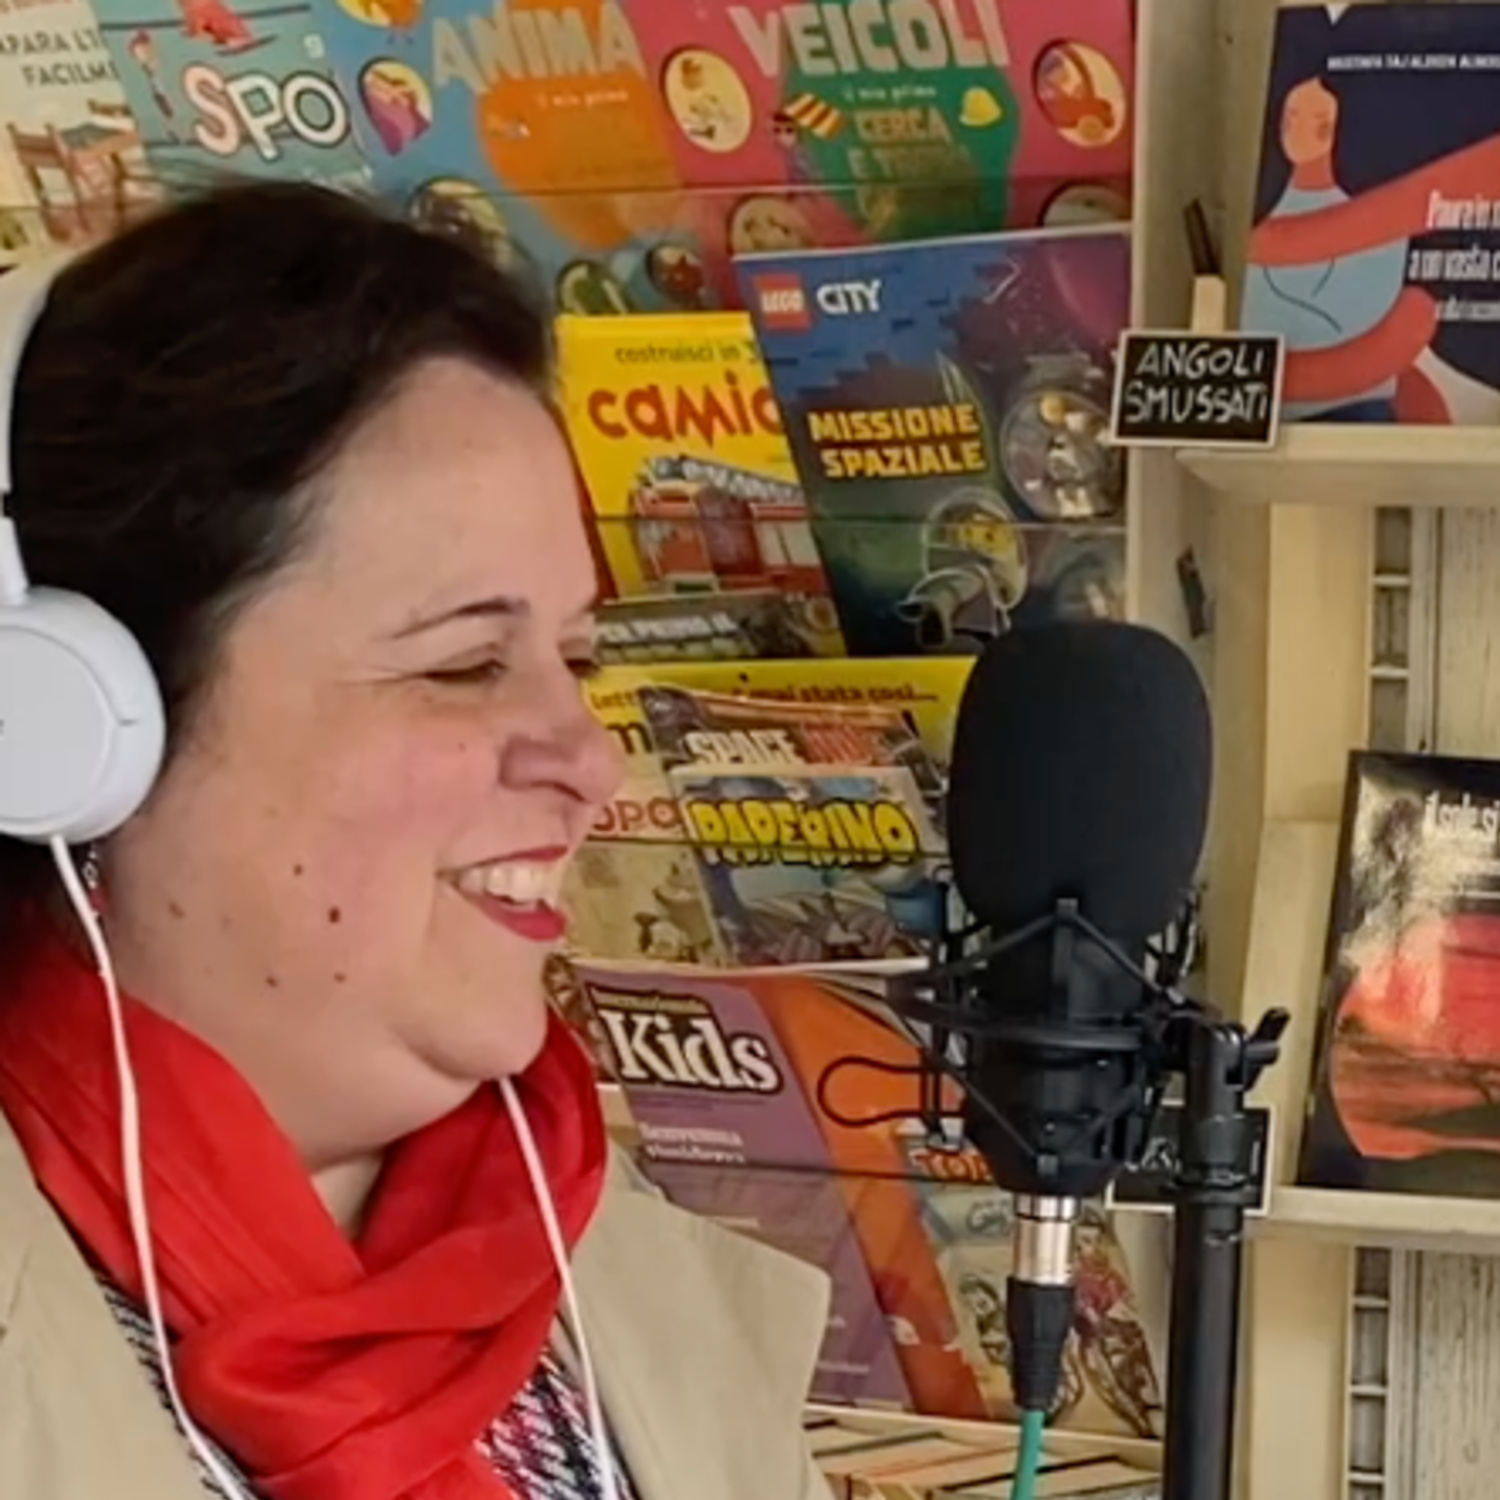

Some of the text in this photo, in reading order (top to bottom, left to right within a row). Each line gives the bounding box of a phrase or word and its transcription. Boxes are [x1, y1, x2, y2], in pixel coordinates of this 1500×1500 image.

[726, 0, 1008, 77] VEICOLI
[761, 280, 881, 315] LEGO CITY
[1136, 342, 1263, 378] ANGOLI
[1124, 383, 1269, 424] SMUSSATI
[807, 405, 980, 442] MISSIONE
[821, 440, 985, 478] SPAZIALE
[688, 798, 921, 867] PAPERINO
[598, 1008, 780, 1091] Kids
